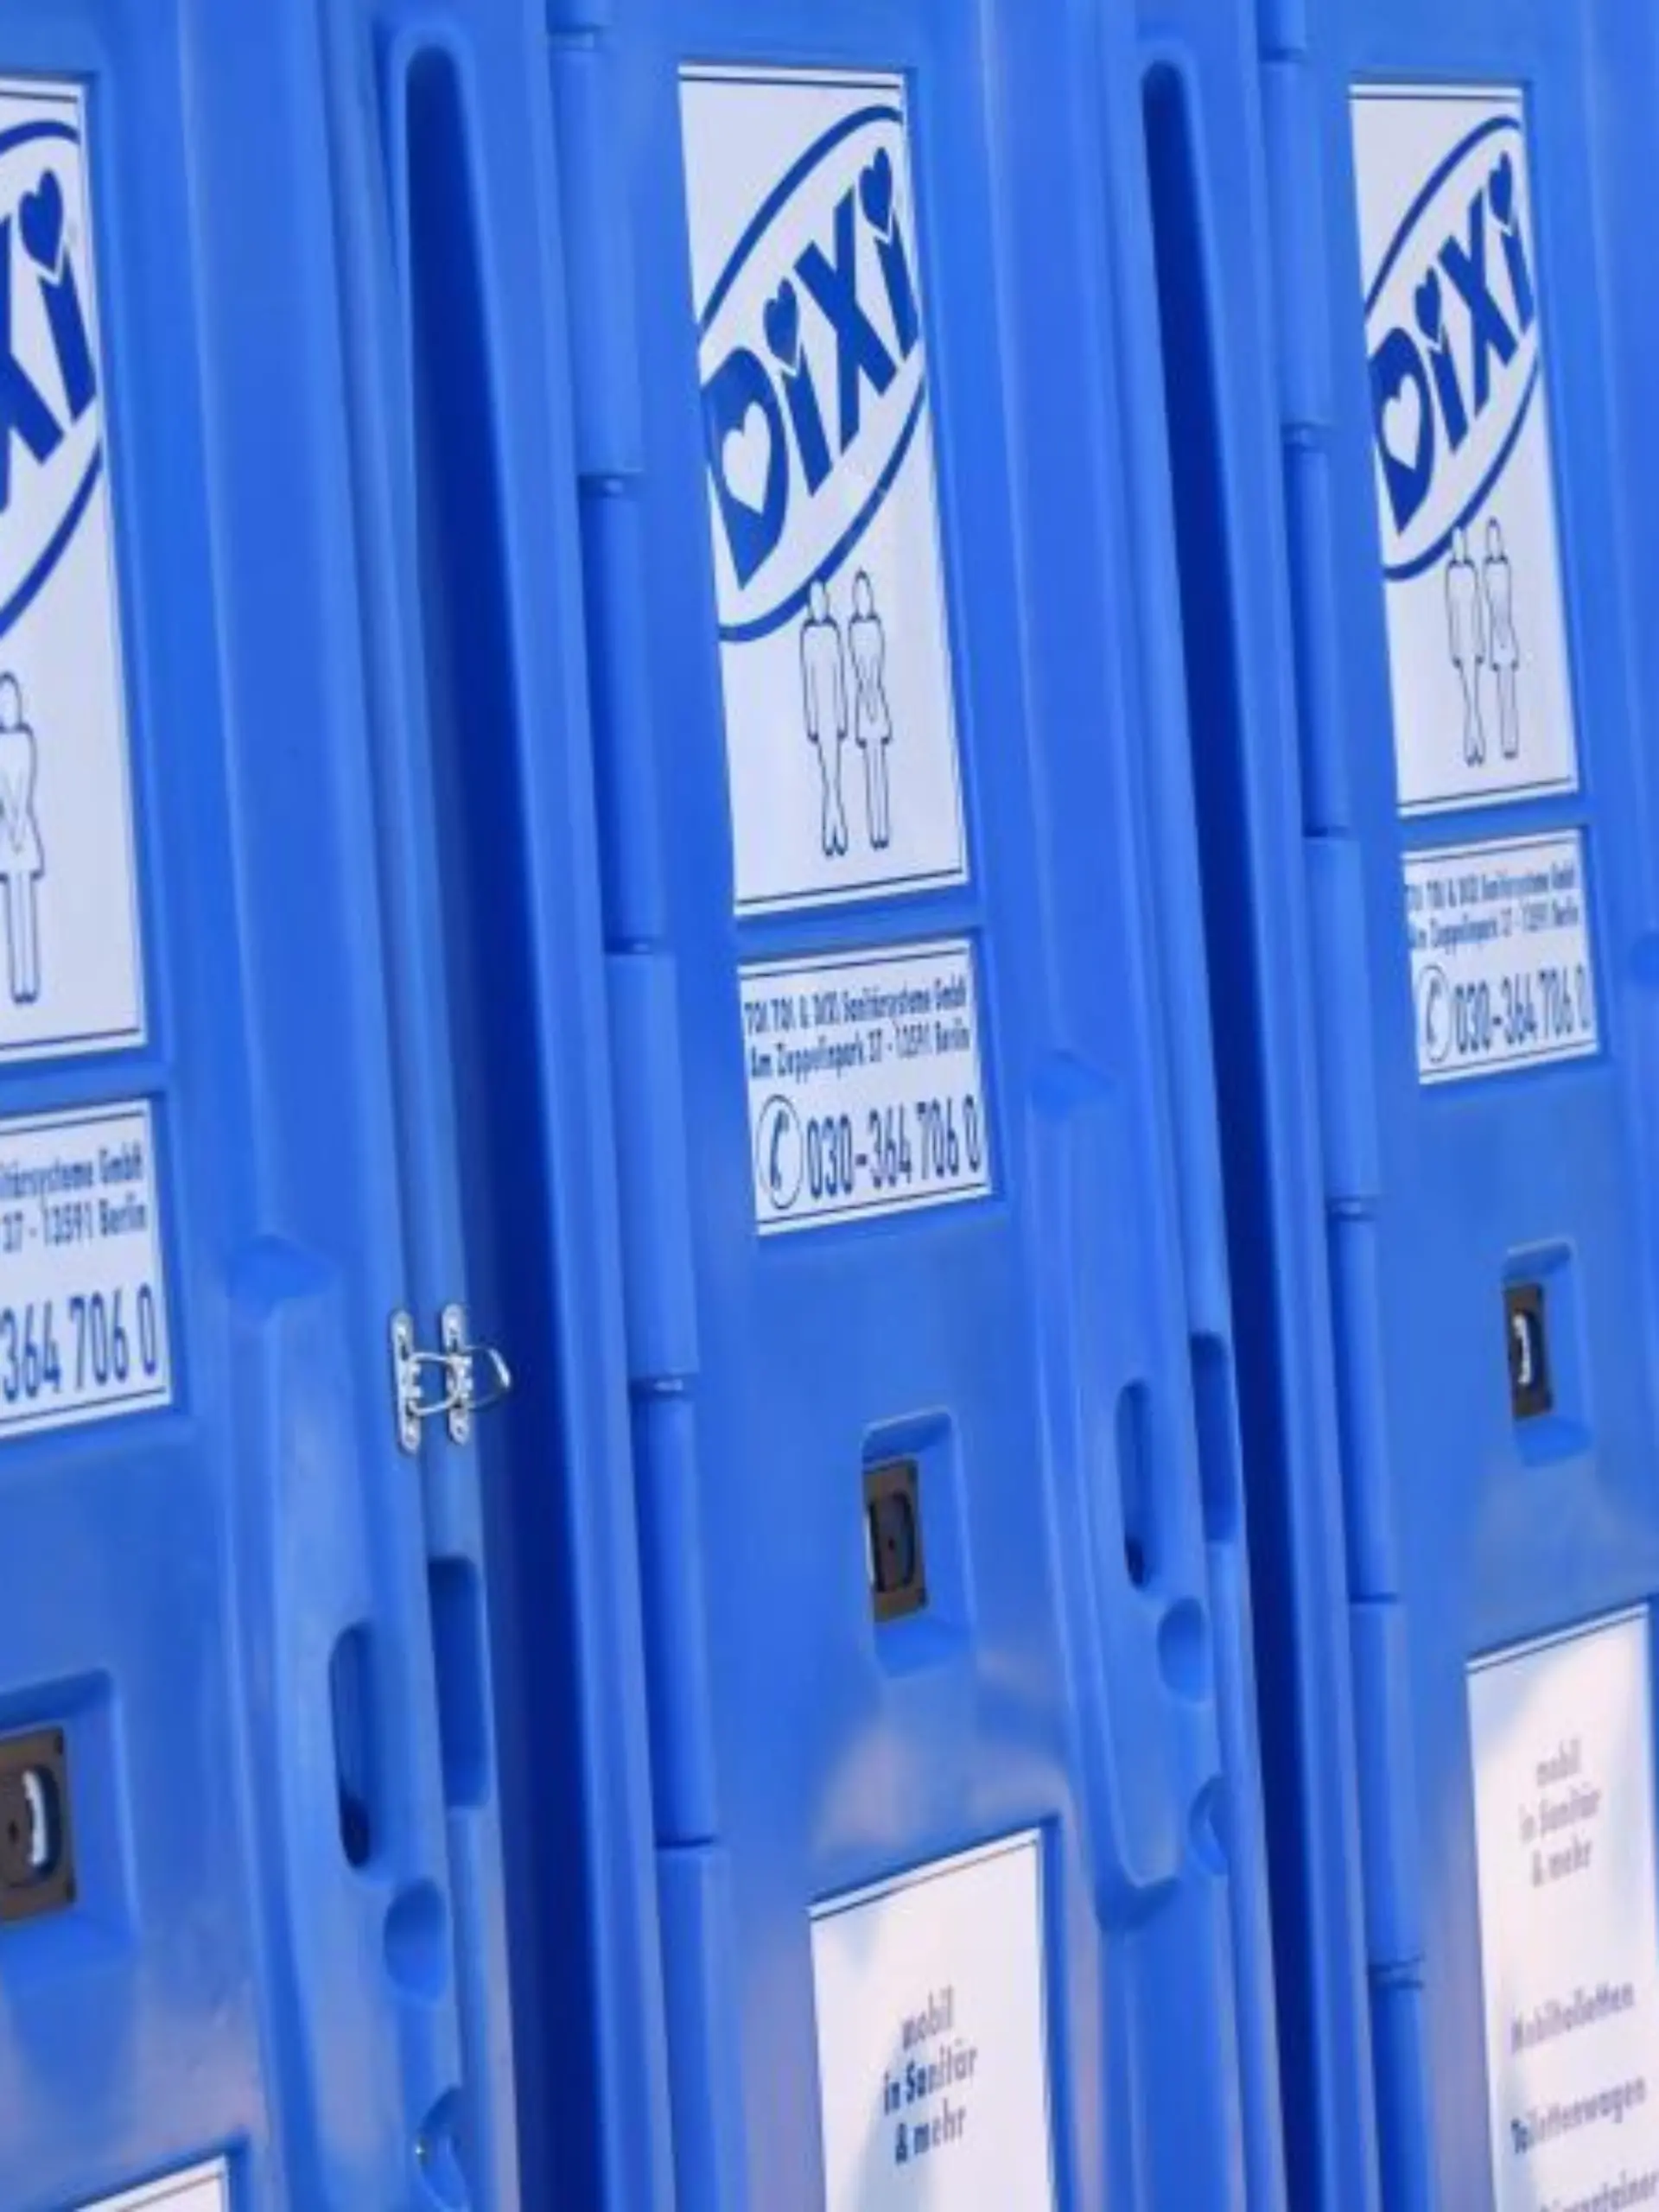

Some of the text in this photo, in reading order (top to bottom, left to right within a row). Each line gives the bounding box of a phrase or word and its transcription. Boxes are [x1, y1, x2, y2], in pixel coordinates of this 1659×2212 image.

[934, 973, 967, 1010] GmbH
[1537, 965, 1574, 1040] 706
[1576, 963, 1589, 1030] 0
[750, 1044, 773, 1078] Am
[935, 1019, 970, 1054] Berlin
[98, 1140, 143, 1185] GmbH
[806, 1092, 982, 1199] 030-364 706 0
[99, 1191, 147, 1236] Berlin
[68, 1287, 130, 1389] 706
[136, 1282, 157, 1377] 0
[902, 1984, 955, 2050] mobil
[883, 2037, 978, 2116] in Sanitär
[913, 2096, 966, 2155] mehr
